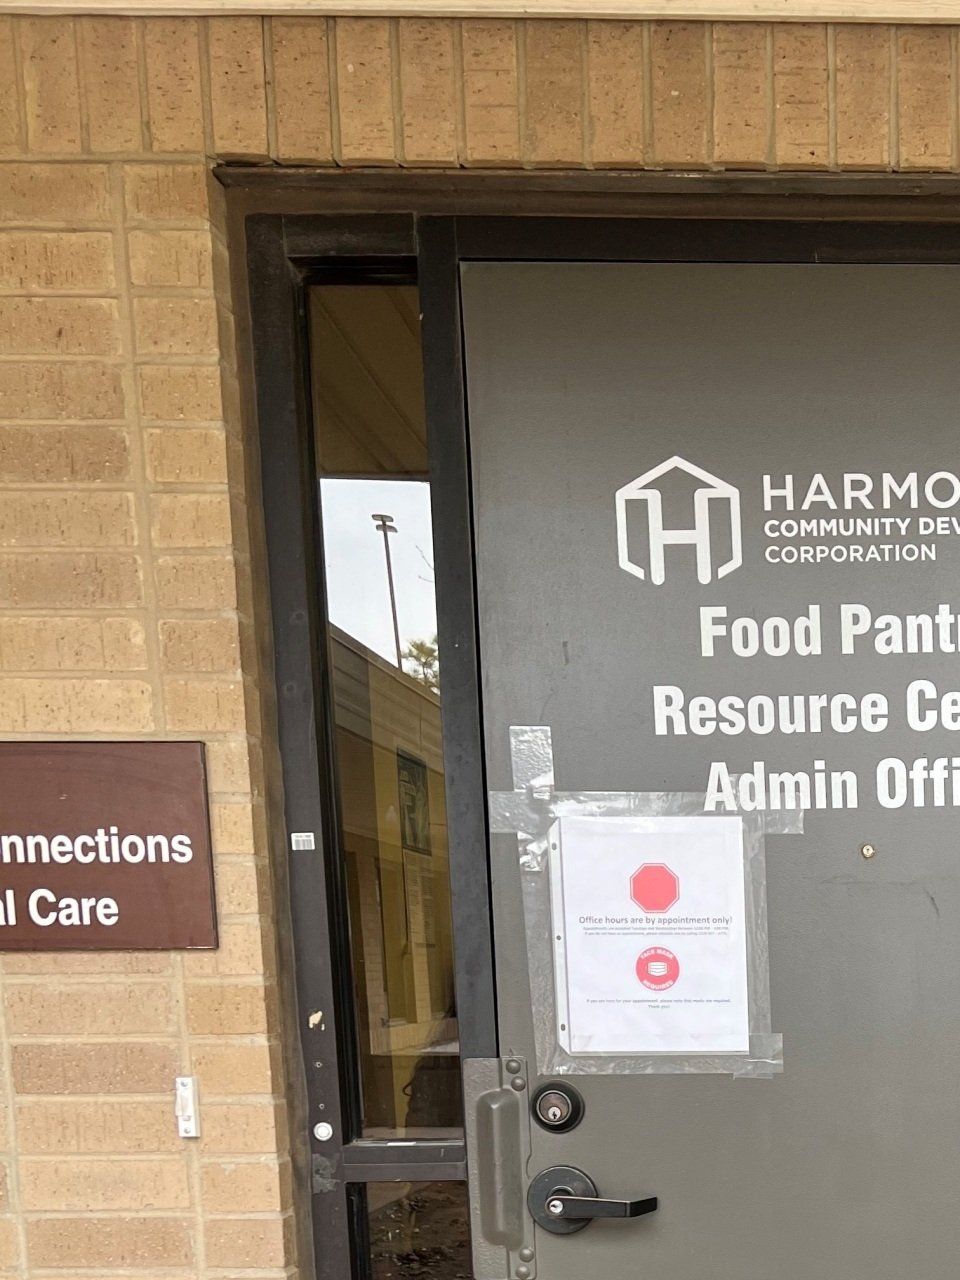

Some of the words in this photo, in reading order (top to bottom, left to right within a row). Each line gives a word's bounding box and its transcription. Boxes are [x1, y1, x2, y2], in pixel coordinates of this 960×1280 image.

[764, 517, 911, 538] COMMUNITY
[764, 543, 936, 564] CORPORATION
[699, 604, 822, 658] Food
[652, 685, 889, 736] Resource
[703, 760, 858, 812] Admin
[1, 826, 193, 864] nnections
[0, 889, 17, 926] l
[28, 888, 119, 926] Care
[579, 916, 603, 924] Office
[605, 916, 629, 924] hours
[645, 916, 656, 925] by
[657, 916, 710, 925] appointment
